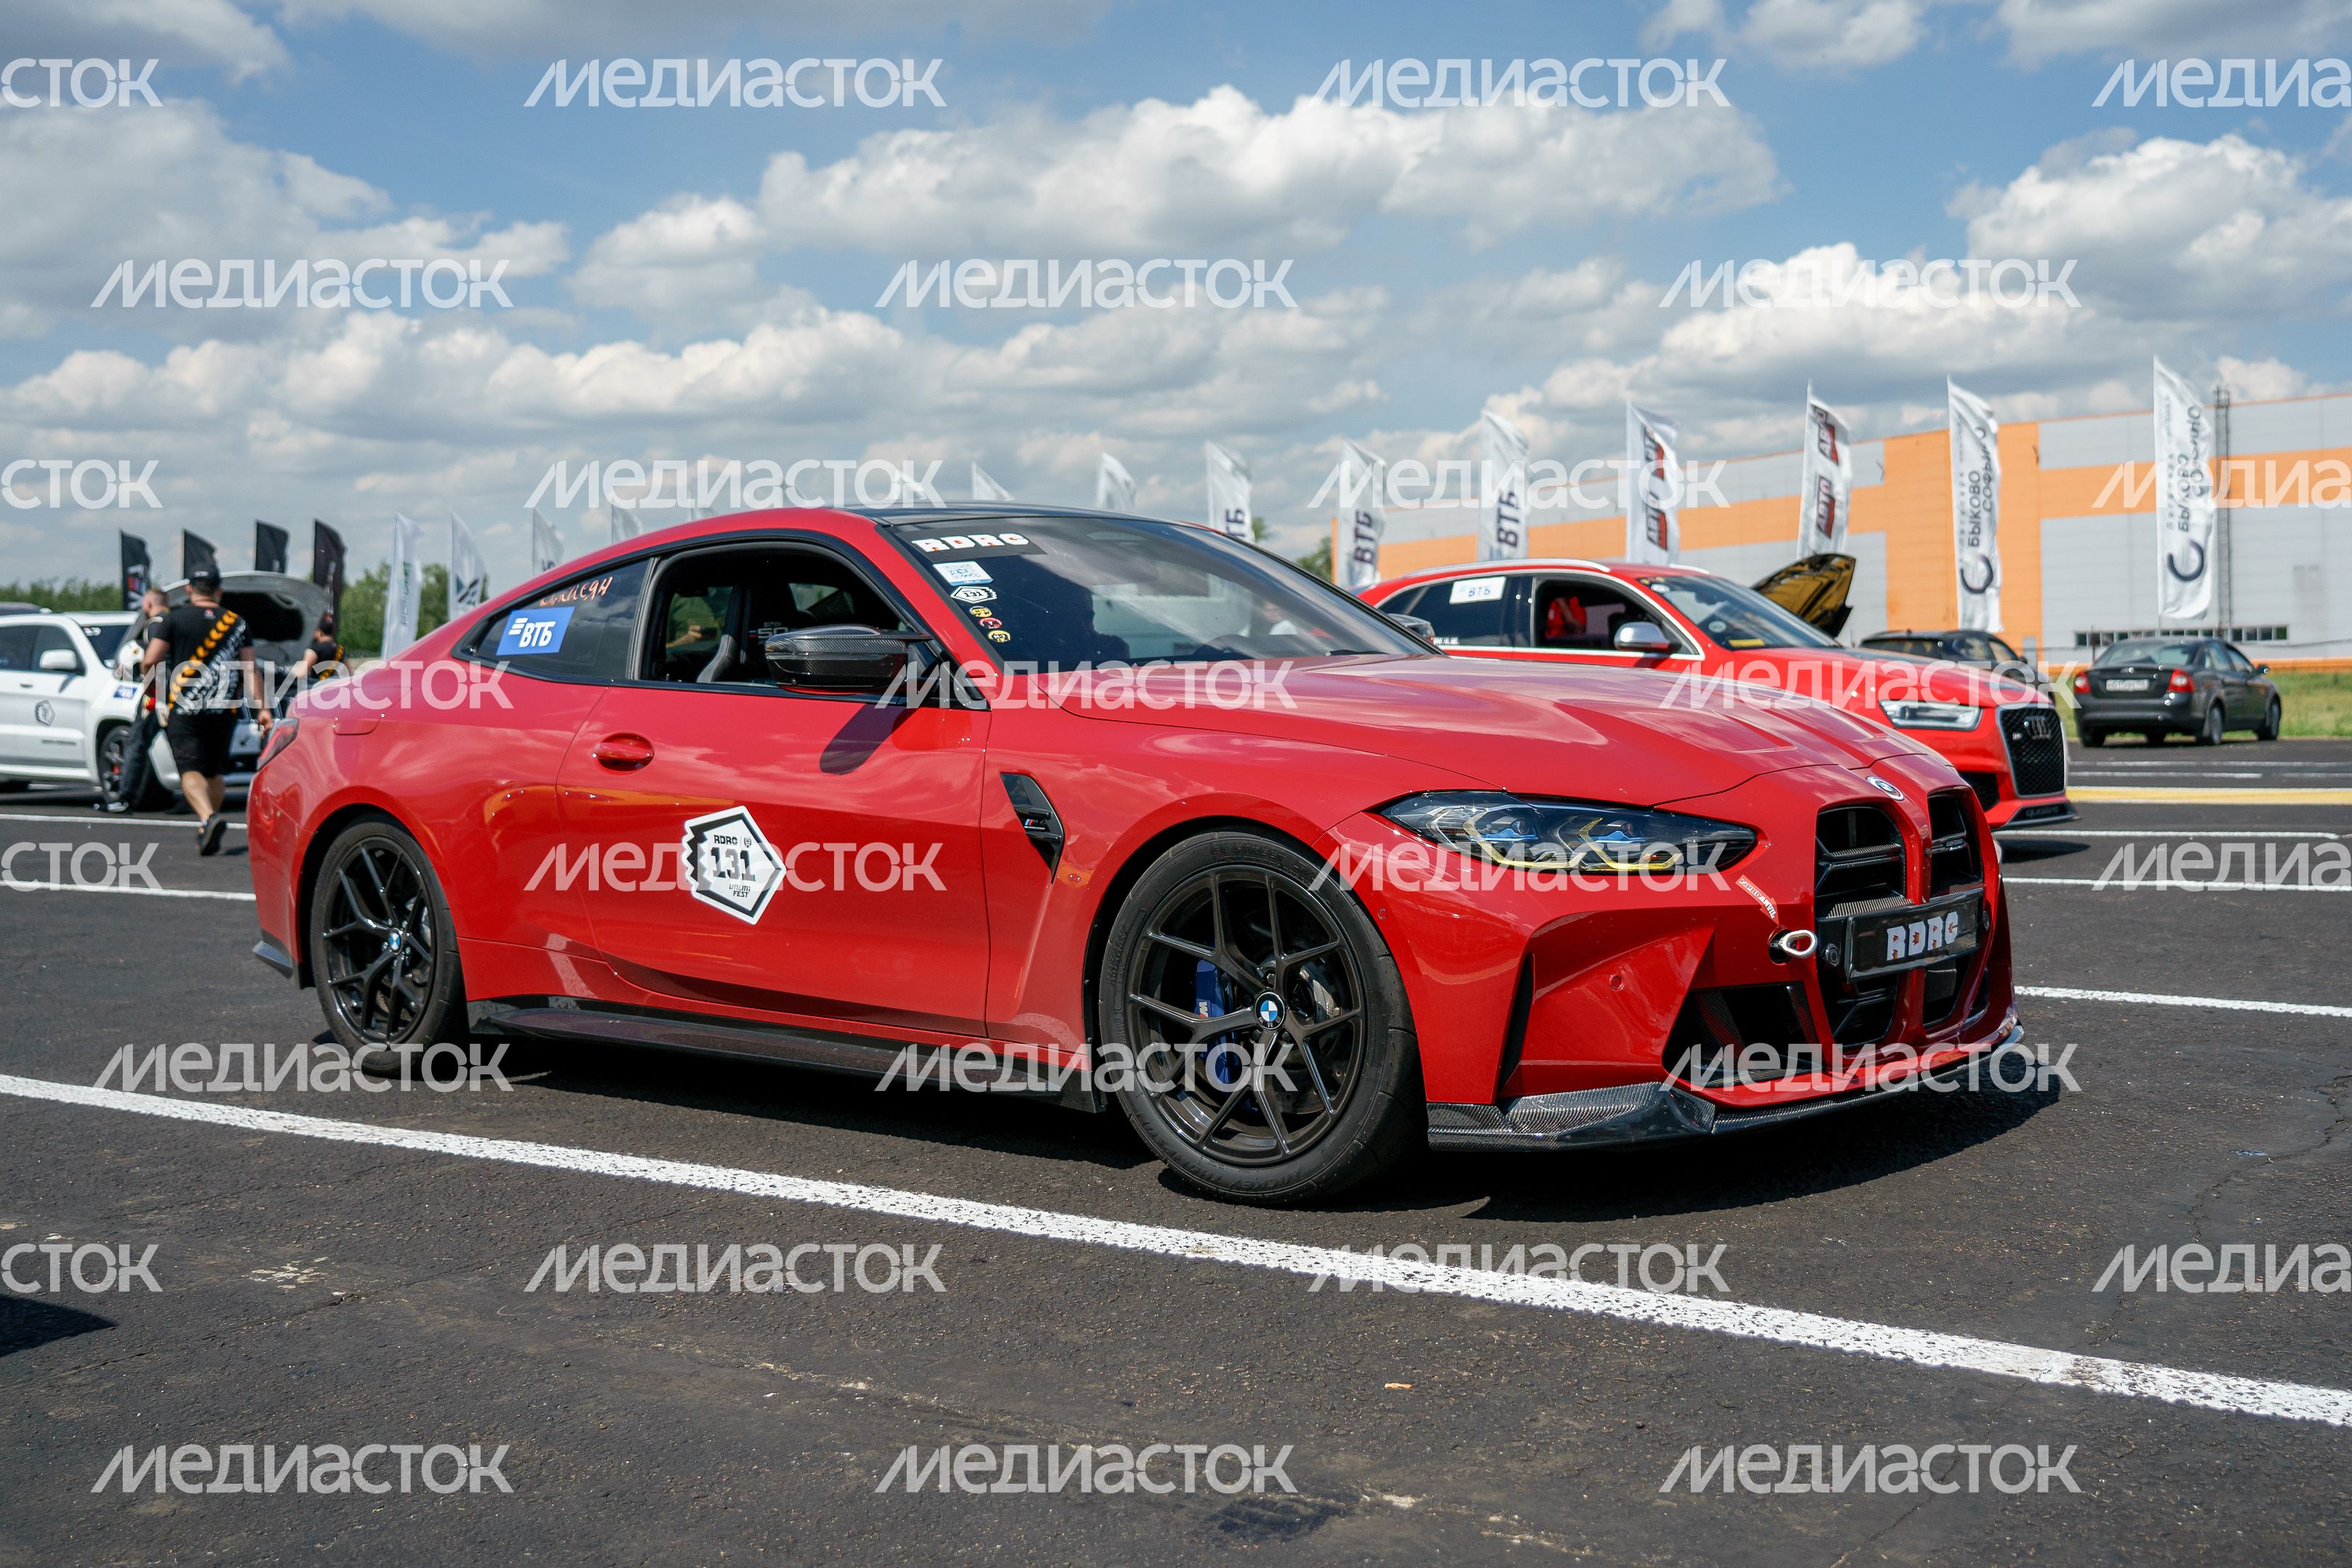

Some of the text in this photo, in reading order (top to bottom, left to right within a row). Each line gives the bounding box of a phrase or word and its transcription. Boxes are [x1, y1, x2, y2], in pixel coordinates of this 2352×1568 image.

[1226, 508, 1246, 537] ТБ
[1498, 490, 1520, 548] ВТБ
[1968, 470, 1980, 547] БЫКОВО
[912, 534, 1029, 552] RDRC
[1352, 510, 1376, 565] ВТБ
[518, 621, 557, 648] ВТБ
[714, 834, 738, 846] RDRC
[711, 846, 756, 882] 131
[1887, 911, 1959, 961] RDRC
